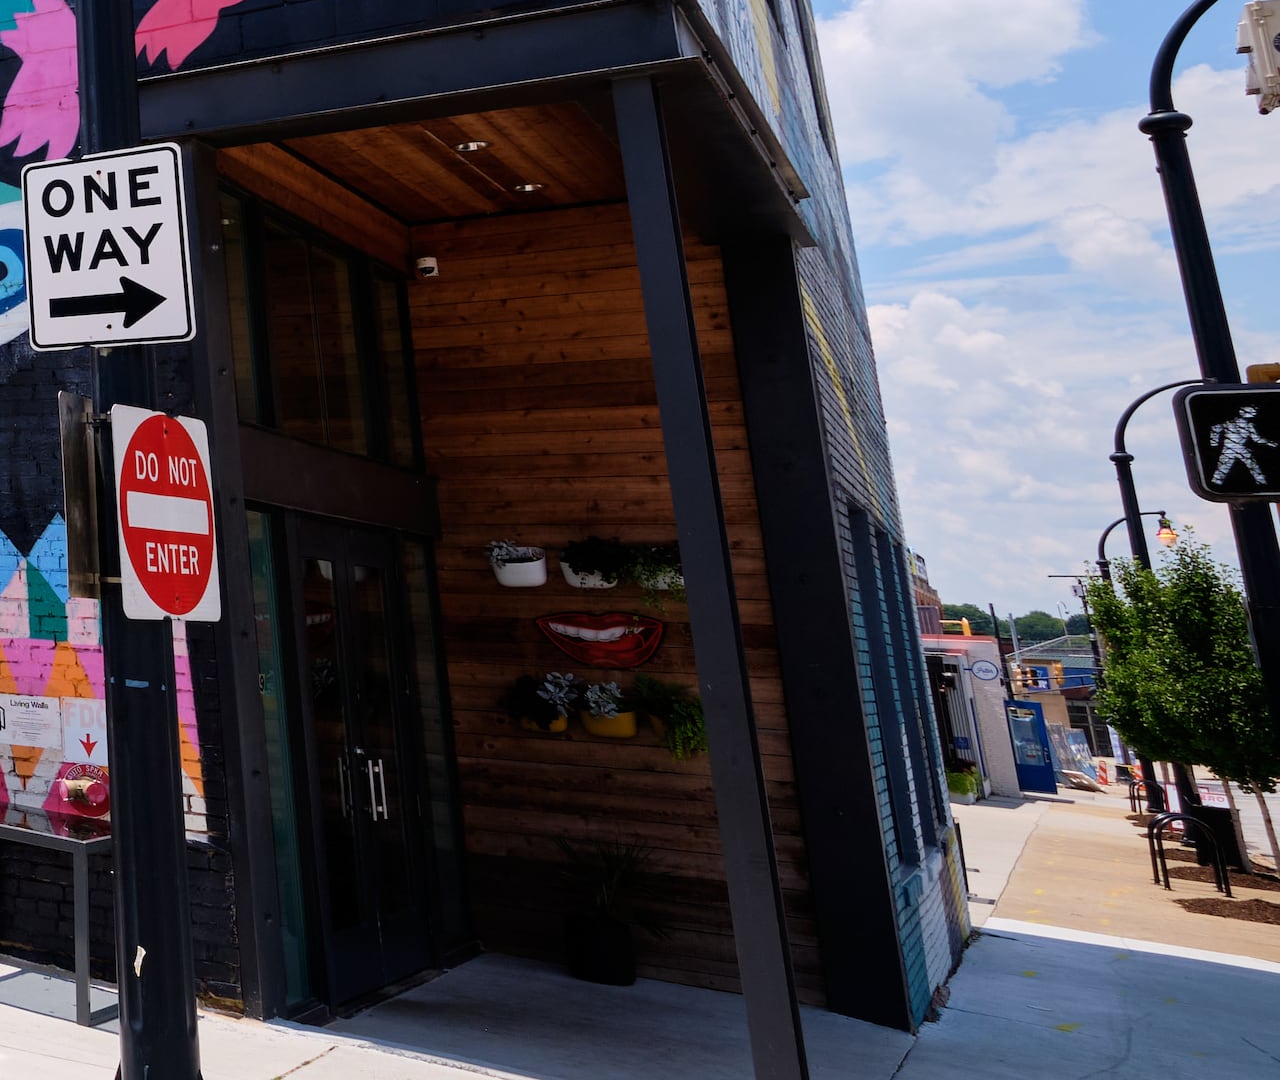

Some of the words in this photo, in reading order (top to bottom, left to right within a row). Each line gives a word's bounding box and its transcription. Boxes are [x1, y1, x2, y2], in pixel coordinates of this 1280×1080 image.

[42, 165, 162, 217] ONE
[43, 222, 163, 273] WAY
[135, 450, 159, 482] DO
[168, 455, 197, 487] NOT
[145, 541, 200, 575] ENTER
[10, 699, 30, 709] Living
[30, 701, 49, 710] Walls
